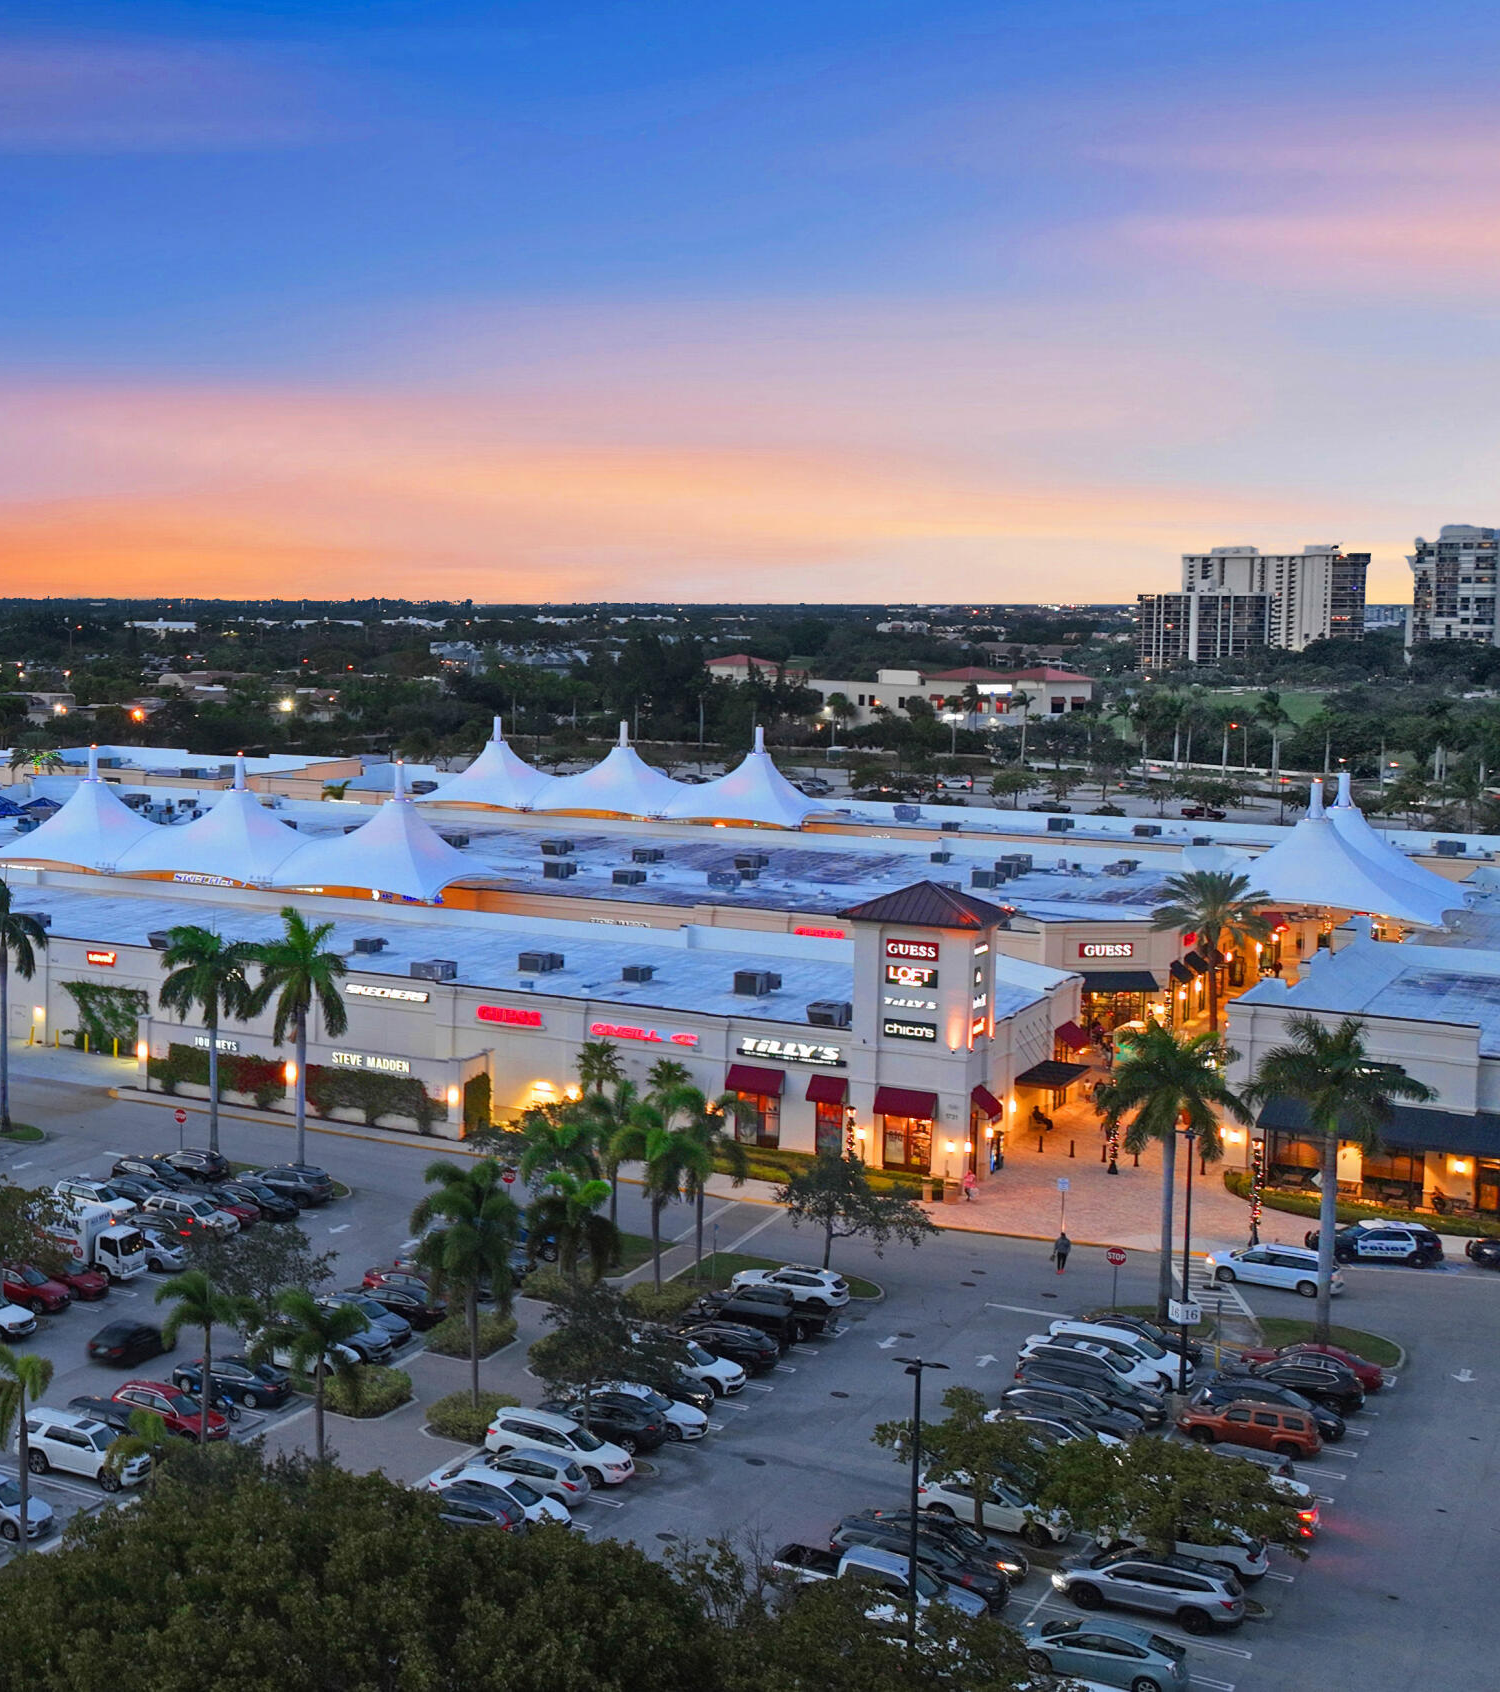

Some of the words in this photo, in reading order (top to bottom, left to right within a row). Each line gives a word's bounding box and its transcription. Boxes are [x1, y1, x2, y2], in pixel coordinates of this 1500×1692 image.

[887, 943, 937, 958] GUESS
[1083, 944, 1132, 957] GUESS
[888, 966, 934, 982] LOFT
[345, 979, 429, 1003] SKECHERS
[476, 1005, 542, 1027] GUESS
[194, 1036, 237, 1051] JOUNEYS
[332, 1051, 363, 1067] STEVE
[366, 1056, 411, 1073] MADDEN
[1360, 1244, 1408, 1252] POLICE
[1107, 1252, 1126, 1261] STOP
[1171, 1305, 1180, 1319] 16
[1185, 1309, 1198, 1320] 16
